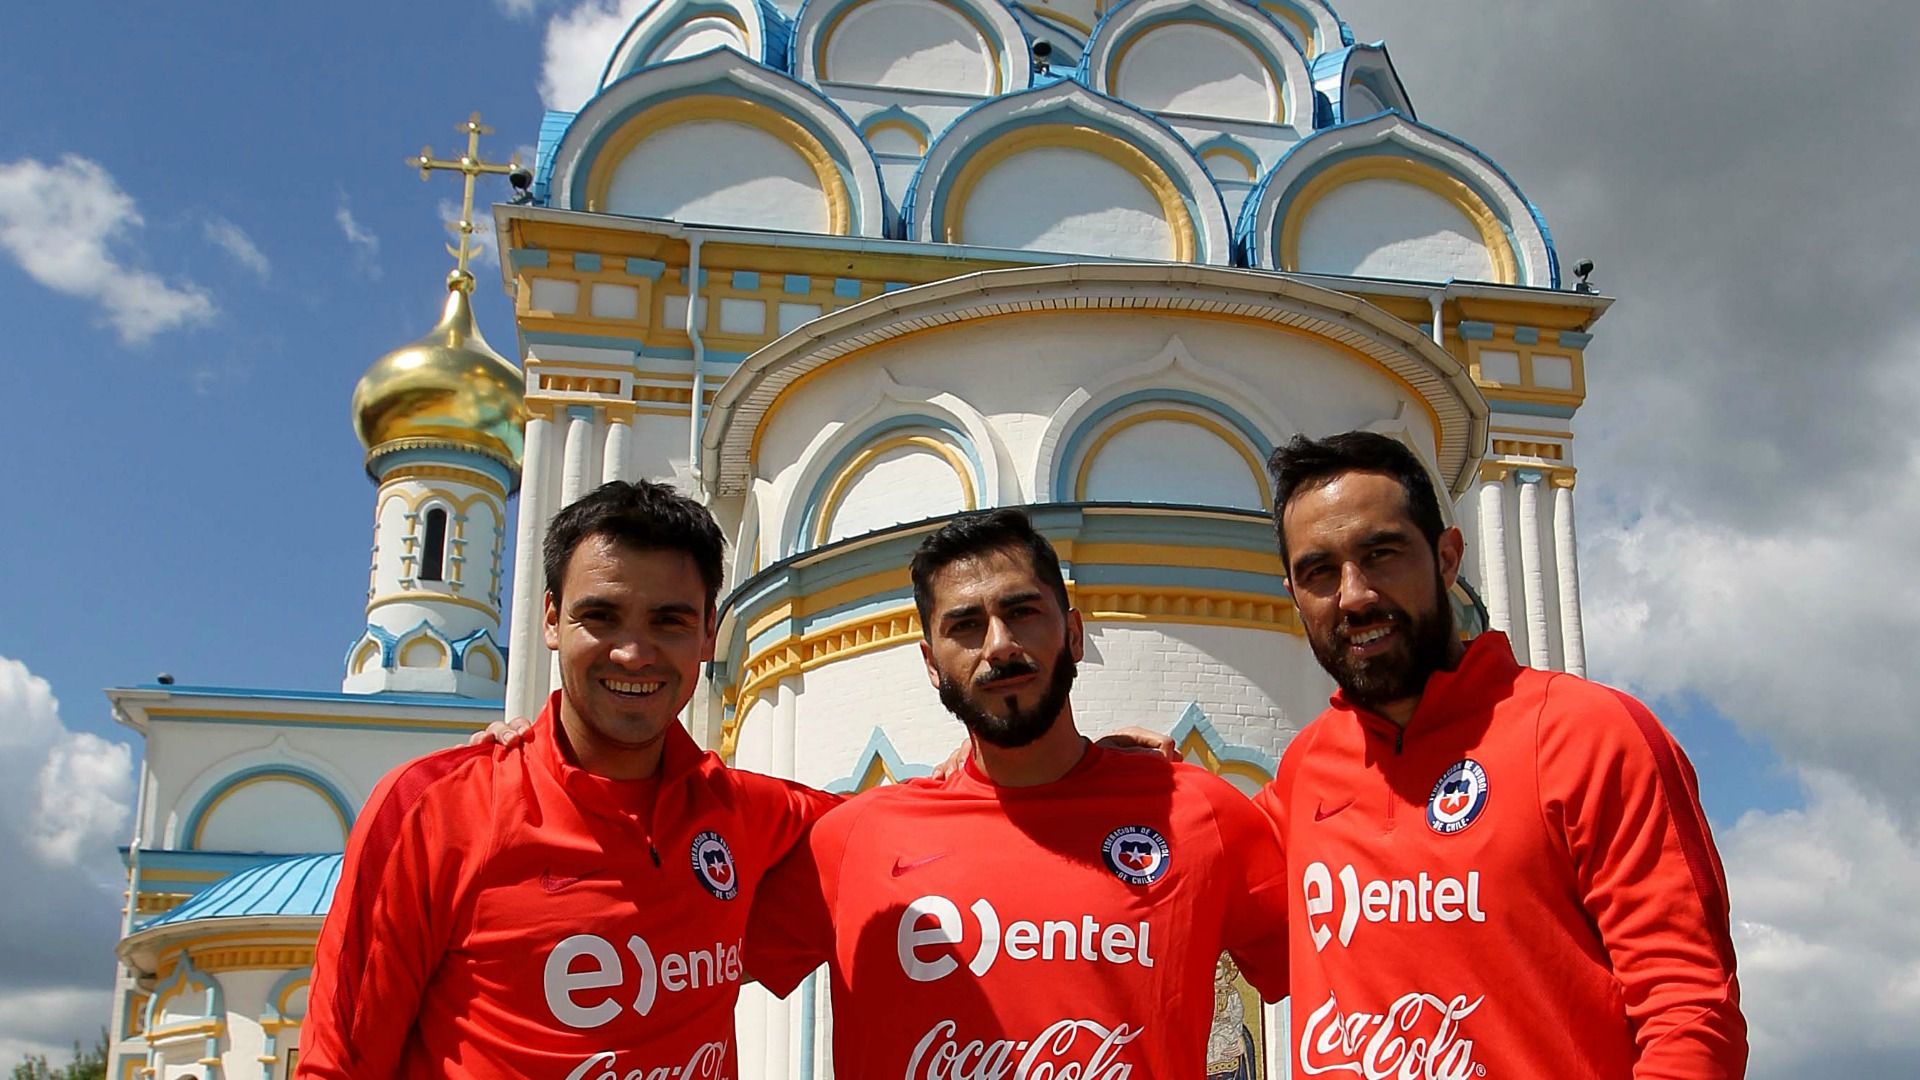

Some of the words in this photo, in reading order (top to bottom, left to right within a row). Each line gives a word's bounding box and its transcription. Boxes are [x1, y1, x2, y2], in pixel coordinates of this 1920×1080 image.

[1140, 827, 1151, 835] DE
[1433, 820, 1444, 831] DE
[1446, 818, 1467, 832] CHILE
[1131, 875, 1154, 884] CHILE
[1361, 871, 1486, 922] entel
[1004, 914, 1154, 967] entel
